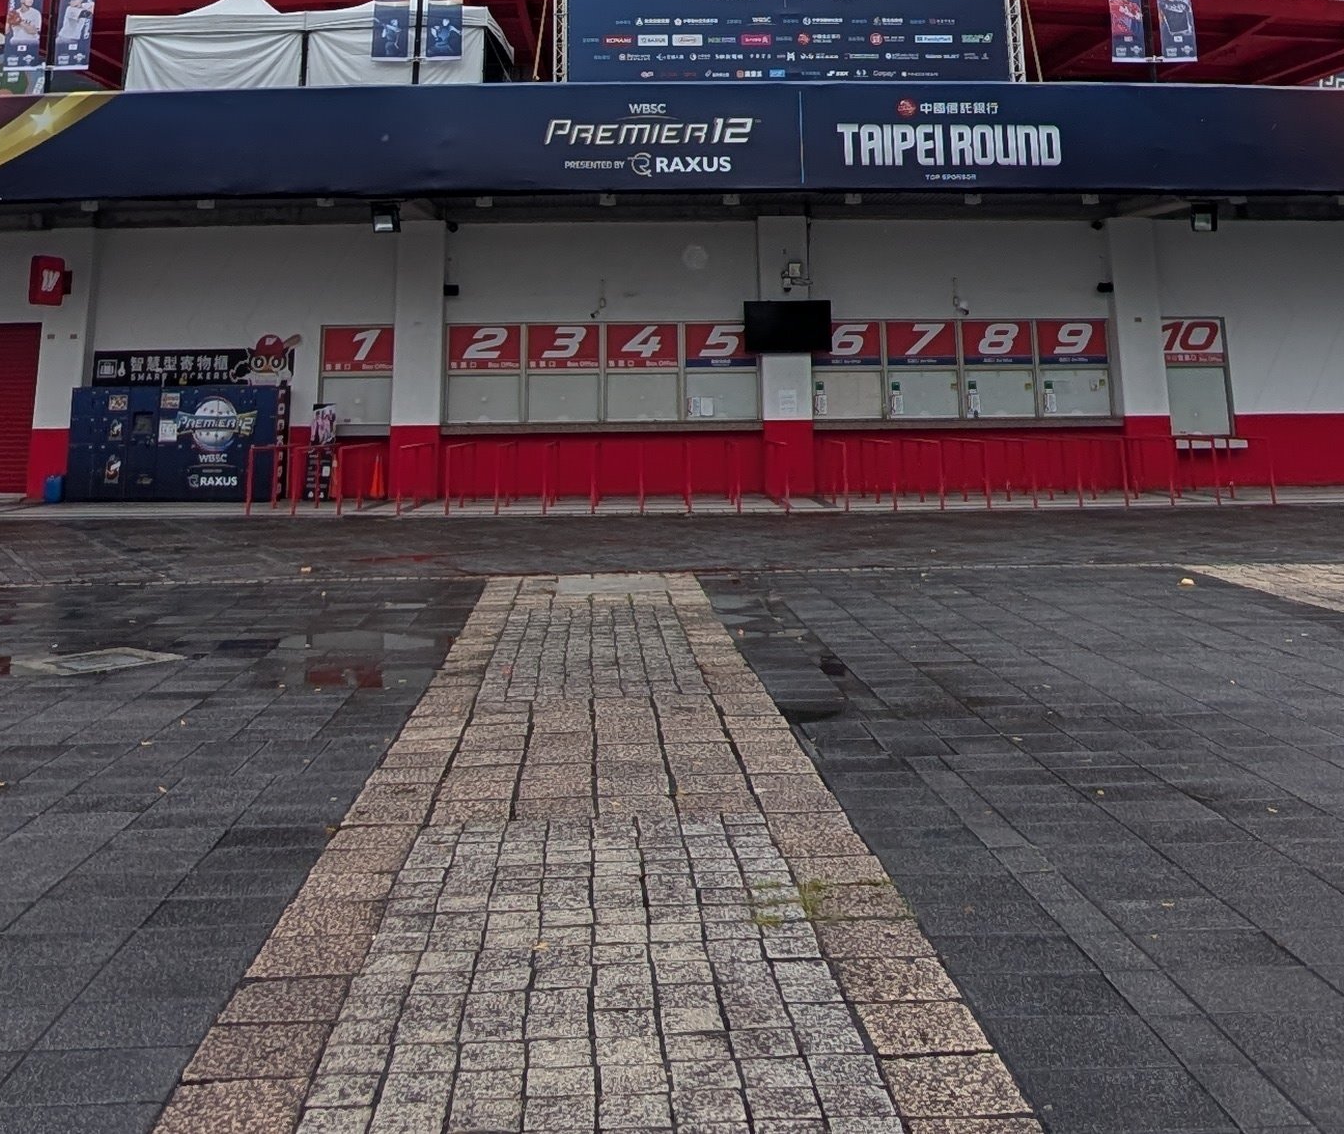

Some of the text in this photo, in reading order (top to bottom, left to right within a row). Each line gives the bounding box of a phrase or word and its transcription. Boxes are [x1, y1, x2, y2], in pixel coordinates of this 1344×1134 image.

[629, 104, 666, 114] WBSC
[920, 102, 998, 114] 中國信託銀行
[837, 124, 1062, 166] TAIPEI ROUND
[565, 161, 625, 169] PRESENTED BY
[656, 156, 732, 172] RAXUS
[353, 330, 382, 360] 1
[462, 327, 508, 359] 2
[541, 326, 587, 358] 3
[621, 326, 661, 357] 4
[699, 325, 745, 356] 5
[829, 323, 868, 355] 6
[905, 324, 945, 355] 7
[979, 323, 1019, 354] 8
[1054, 323, 1093, 354] 9
[1161, 321, 1218, 351] 10
[199, 453, 228, 463] WBSC
[200, 476, 238, 486] RAXUS
